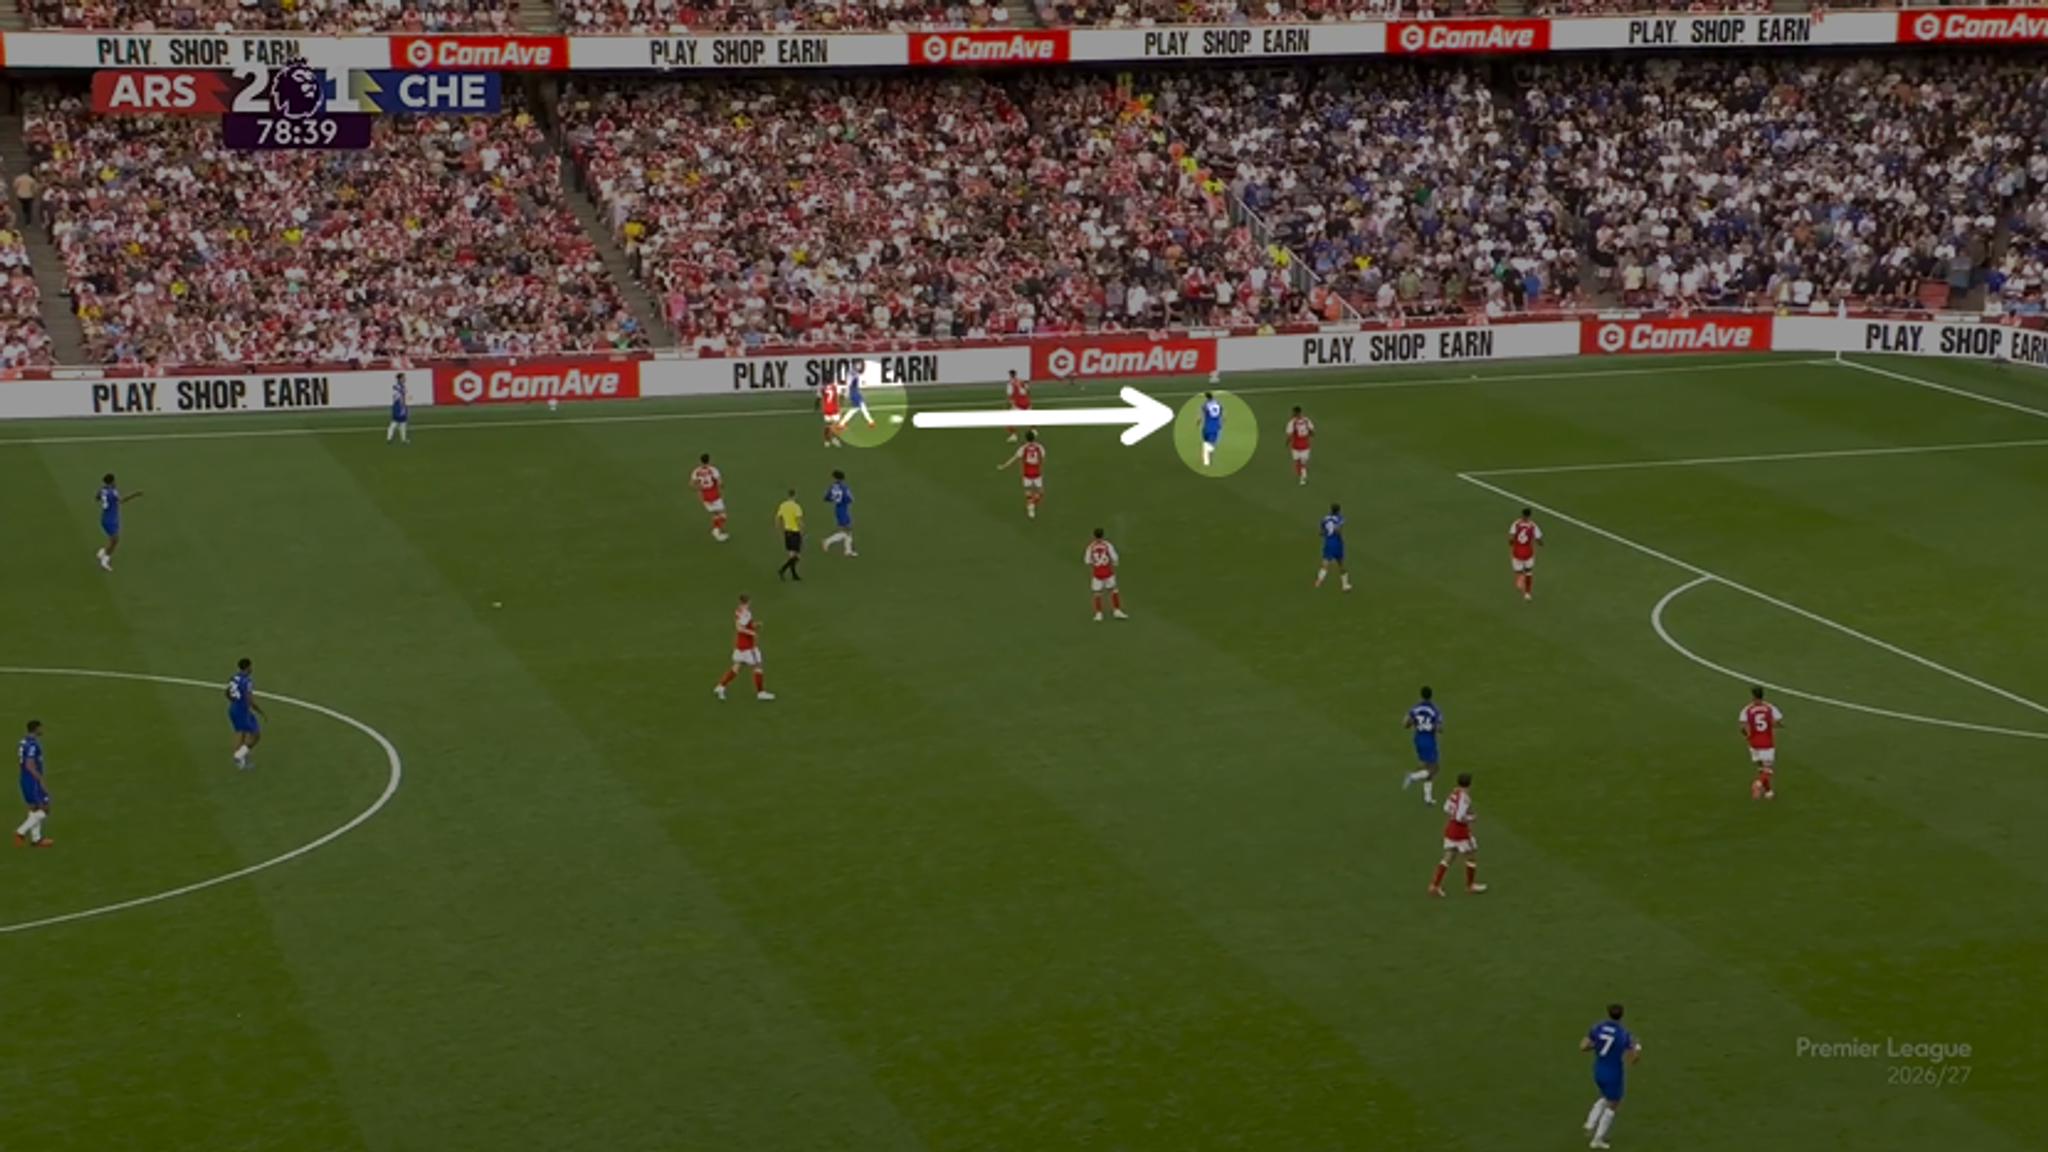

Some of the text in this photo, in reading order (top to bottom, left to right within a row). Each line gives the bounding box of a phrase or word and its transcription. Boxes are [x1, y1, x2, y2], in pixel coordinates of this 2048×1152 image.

[1263, 28, 1310, 53] EARN
[1427, 25, 1534, 48] ComAve
[1757, 17, 1811, 42] EARN
[437, 41, 551, 65] ComAve
[778, 38, 828, 64] EARN
[952, 36, 1054, 60] ComAve
[1439, 330, 1493, 357] EARN
[1630, 323, 1753, 349] ComAve
[881, 355, 938, 383] EARN
[1080, 346, 1198, 374] ComAve
[263, 377, 329, 407] EARN
[489, 369, 619, 398] ComAve
[1517, 528, 1528, 544] 6
[1093, 552, 1109, 567] 36
[1754, 712, 1768, 732] 5
[1599, 1033, 1615, 1056] 7
